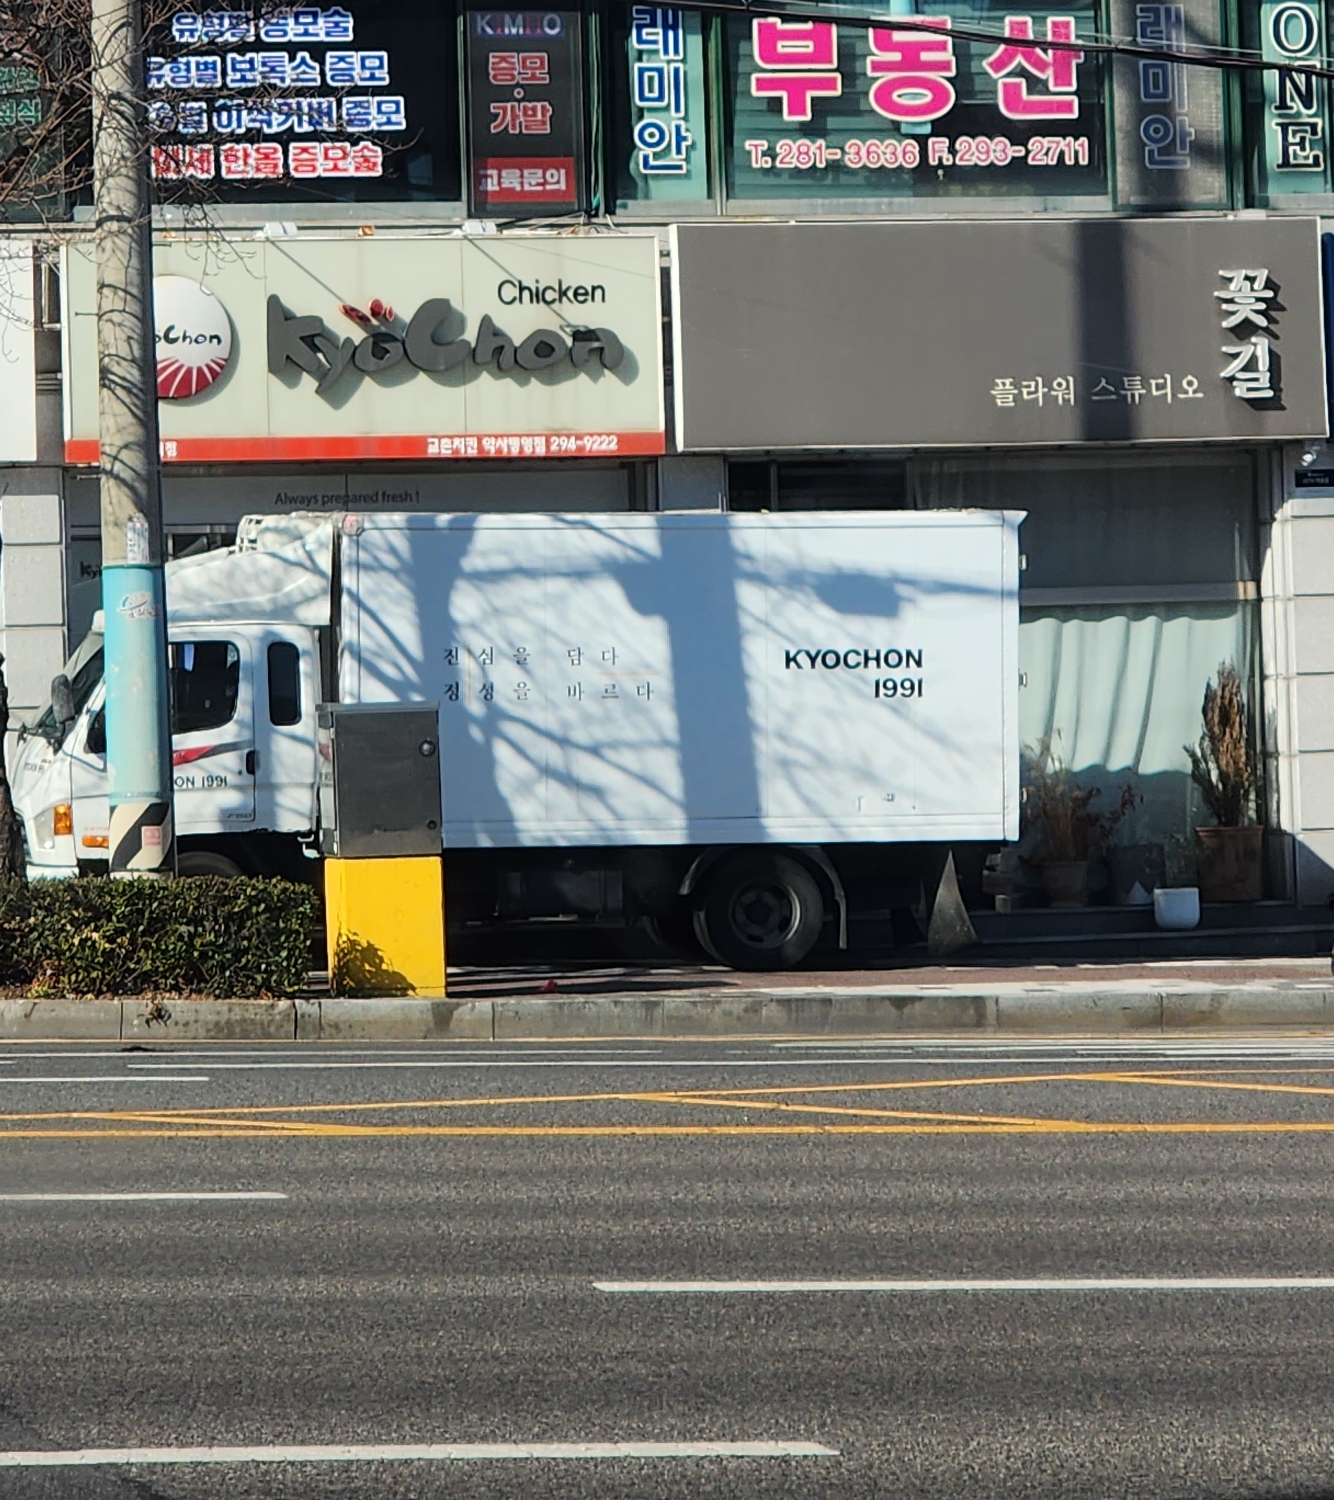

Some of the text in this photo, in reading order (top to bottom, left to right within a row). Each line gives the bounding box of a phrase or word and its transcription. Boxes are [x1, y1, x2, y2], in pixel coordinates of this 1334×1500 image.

[225, 51, 322, 89] 보톡스
[326, 50, 390, 87] 증모
[487, 51, 551, 86] 증모
[750, 15, 1085, 122] 부동산
[1135, 2, 1195, 170] 래미안
[631, 4, 693, 174] 래미안
[1269, 0, 1326, 174] ONE
[488, 101, 553, 136] 가발
[288, 140, 384, 179] 증모술
[745, 136, 1090, 169] T.281-3636 F.293-2711
[478, 166, 567, 193] 교육문의
[498, 278, 607, 306] Chicken
[1214, 268, 1276, 400] 꽃길
[989, 372, 1205, 408] 플라워 스튜디오
[550, 434, 619, 454] 294-9222
[274, 491, 318, 507] Always
[381, 489, 413, 504] fresh
[783, 648, 924, 670] KYOCHON
[873, 676, 924, 699] 1991
